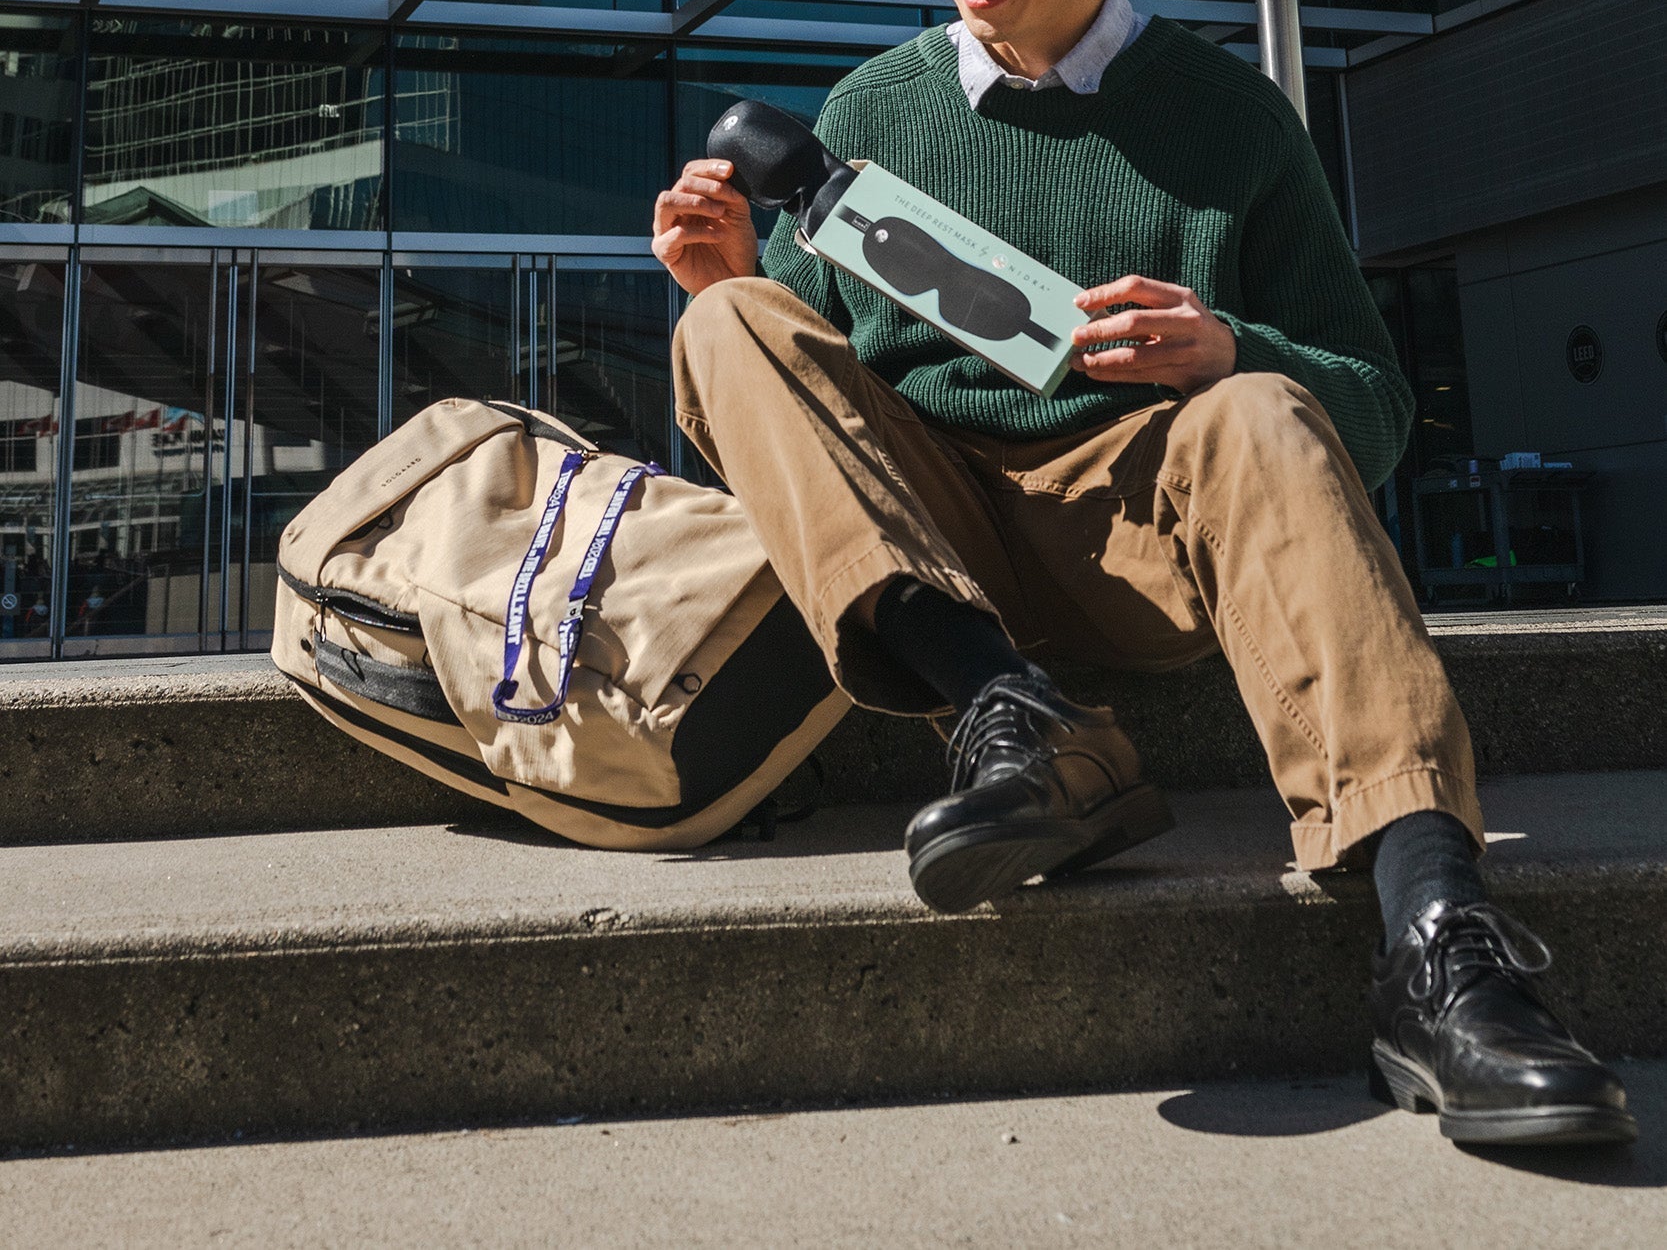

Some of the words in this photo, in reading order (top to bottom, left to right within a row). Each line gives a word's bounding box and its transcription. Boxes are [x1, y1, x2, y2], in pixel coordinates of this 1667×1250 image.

[894, 195, 912, 208] THE
[911, 205, 932, 221] DEEP
[932, 219, 954, 234] REST
[954, 231, 978, 250] MASK
[578, 537, 607, 580] TED2024
